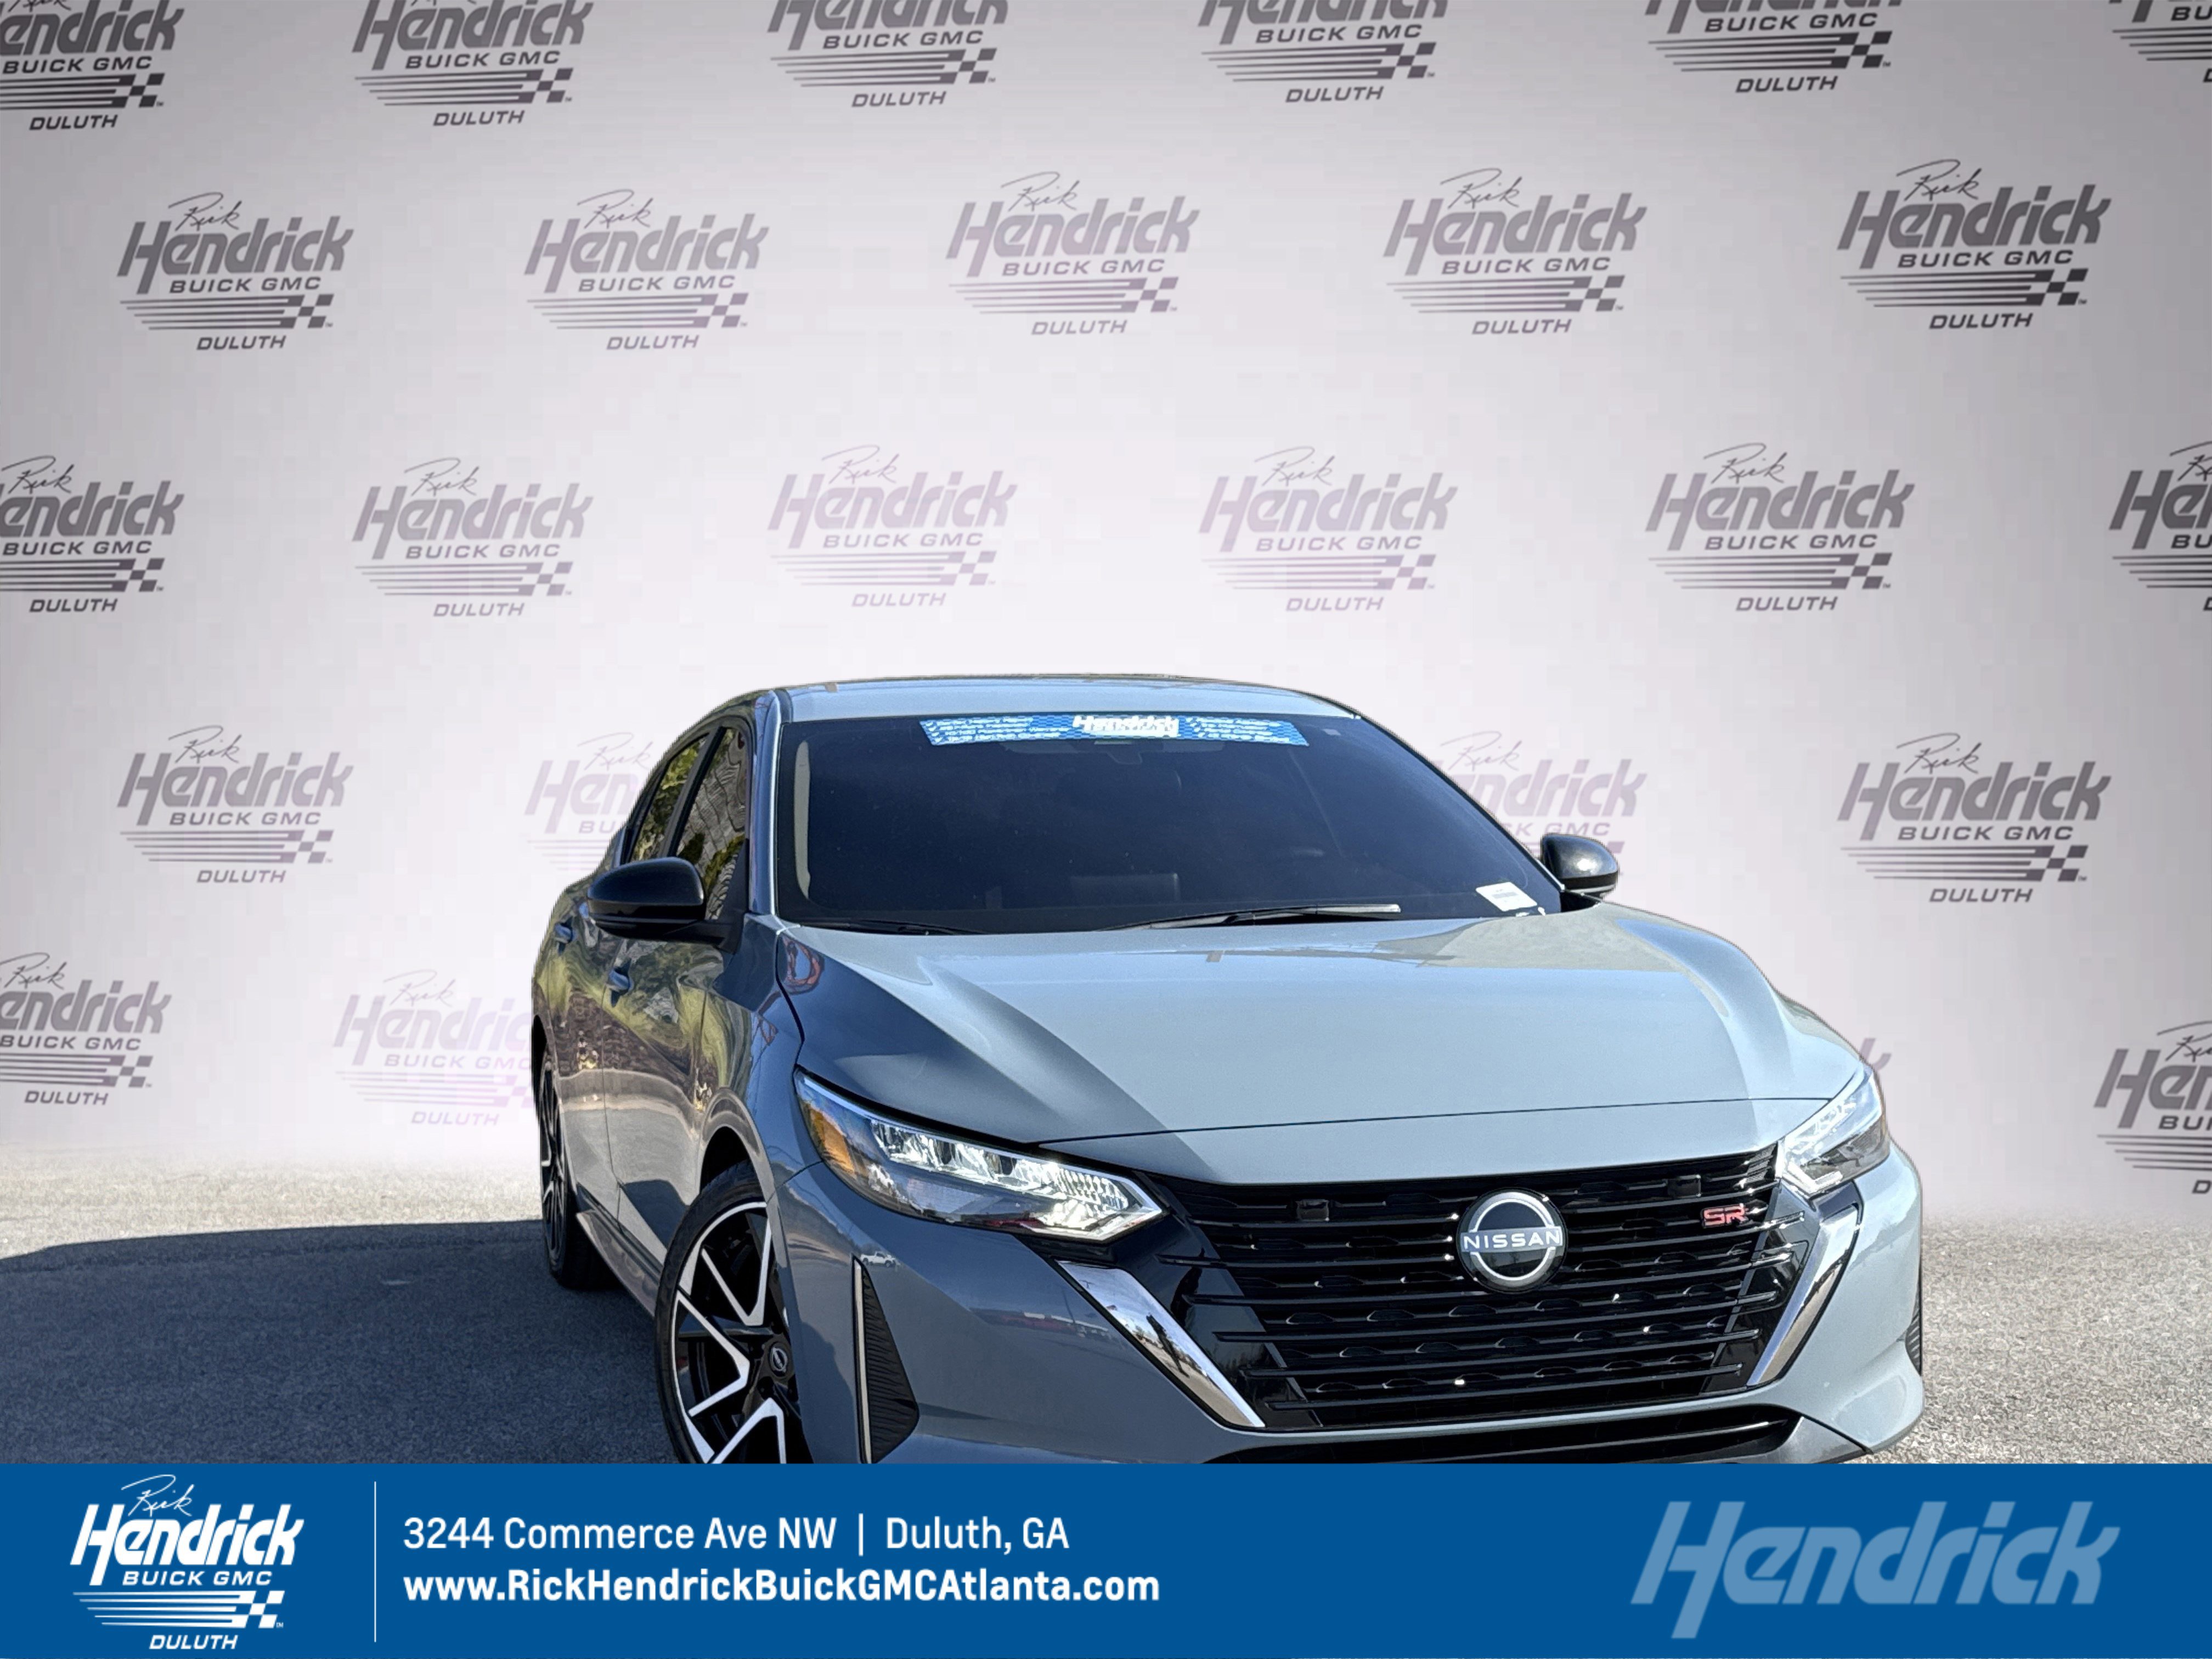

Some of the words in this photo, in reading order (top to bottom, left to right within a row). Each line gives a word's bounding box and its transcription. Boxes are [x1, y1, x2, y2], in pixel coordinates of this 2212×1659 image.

[0, 0, 184, 56] endrick
[1705, 15, 1798, 32] BUICK
[1809, 13, 1874, 29] GMC
[352, 0, 594, 70] Hendrick
[823, 33, 910, 49] BUICK
[920, 30, 983, 46] GMC
[1256, 27, 1346, 43] BUICK
[1357, 24, 1420, 40] GMC
[3, 58, 84, 74] BUICK
[93, 56, 152, 71] GMC
[405, 53, 489, 69] BUICK
[499, 50, 560, 65] GMC
[1736, 76, 1835, 93] DULUTH
[851, 91, 946, 107] DULUTH
[1285, 86, 1383, 103] DULUTH
[30, 115, 118, 130] DULUTH
[433, 110, 524, 126] DULUTH
[1384, 193, 1647, 275] Hendrick
[1837, 184, 2111, 269] Hendrick
[946, 196, 1200, 278] Hendrick
[117, 216, 353, 295] Hendrick
[524, 213, 769, 294] Hendrick
[1898, 252, 1993, 268] BUICK
[2004, 250, 2073, 265] GMC
[1002, 261, 1091, 276] BUICK
[1101, 259, 1165, 273] GMC
[1442, 259, 1533, 274] BUICK
[1544, 257, 1610, 272] GMC
[170, 278, 252, 294] BUICK
[261, 276, 321, 291] GMC
[578, 277, 663, 292] BUICK
[674, 275, 735, 290] GMC
[1031, 320, 1127, 335] DULUTH
[1472, 319, 1572, 334] DULUTH
[1929, 313, 2033, 329] DULUTH
[197, 335, 286, 350] DULUTH
[607, 335, 699, 350] DULUTH
[0, 481, 184, 538] endrick
[768, 471, 1018, 549] Hendrick
[1199, 472, 1458, 552] Hendrick
[1646, 470, 1915, 551] Hendrick
[352, 483, 593, 560] Hendrick
[3, 541, 84, 556] BUICK
[93, 541, 152, 554] GMC
[823, 533, 910, 549] BUICK
[920, 533, 983, 546] GMC
[1256, 537, 1346, 551] BUICK
[1357, 536, 1422, 550] GMC
[1705, 535, 1798, 550] BUICK
[1809, 534, 1877, 549] GMC
[405, 545, 489, 559] BUICK
[499, 544, 560, 558] GMC
[30, 599, 118, 612] DULUTH
[851, 592, 946, 607] DULUTH
[1286, 597, 1384, 611] DULUTH
[1736, 596, 1838, 611] DULUTH
[433, 603, 524, 617] DULUTH
[117, 752, 353, 826] Hendrick
[1448, 759, 1647, 817] ndrick
[1838, 761, 2111, 840] Hendrick
[170, 812, 252, 826] BUICK
[262, 812, 320, 825] GMC
[1544, 822, 1611, 836] GMC
[1898, 826, 1993, 840] BUICK
[2004, 826, 2073, 840] GMC
[197, 870, 286, 883] DULUTH
[1929, 888, 2033, 902] DULUTH
[0, 980, 172, 1034] endrick
[333, 994, 532, 1066] Hendric
[0, 1035, 76, 1049] BUICK
[85, 1037, 141, 1051] GMC
[384, 1053, 465, 1068] BUICK
[476, 1056, 532, 1069] GMC
[25, 1091, 109, 1105] DULUTH
[411, 1111, 500, 1126] DULUTH
[1703, 1204, 1749, 1227] SR
[1463, 1228, 1561, 1249] NISSAN
